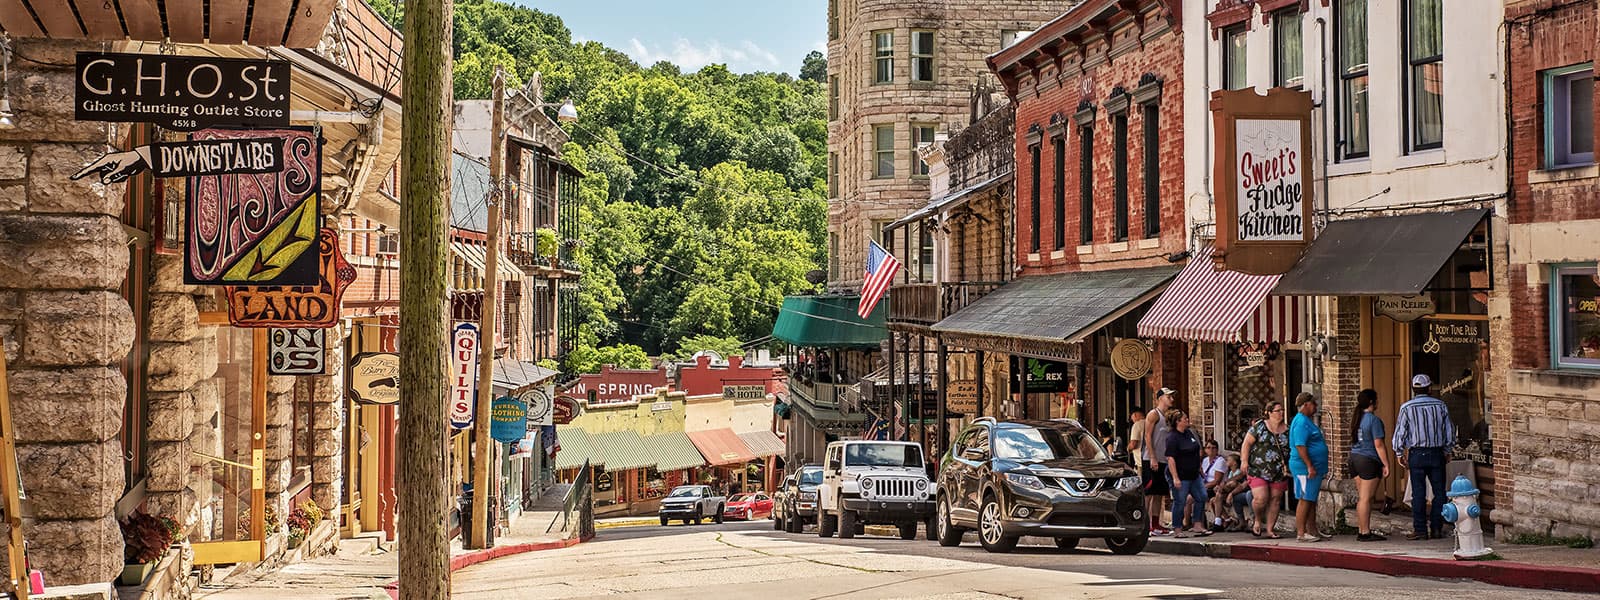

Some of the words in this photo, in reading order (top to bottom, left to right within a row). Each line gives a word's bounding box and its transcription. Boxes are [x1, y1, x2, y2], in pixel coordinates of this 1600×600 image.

[82, 58, 285, 102] G.H.O.St.
[83, 100, 125, 112] Ghost
[130, 102, 189, 117] Hunting
[193, 104, 240, 116] Outlet
[244, 106, 283, 118] Store
[160, 141, 275, 174] DOWNSTAIRS
[1241, 148, 1296, 189] Sweet's
[1246, 178, 1302, 213] Fudge
[1239, 211, 1302, 240] Kitchen
[237, 295, 329, 322] LAND
[1380, 300, 1399, 309] PAIN
[1401, 300, 1430, 309] RELIEF
[1579, 301, 1597, 311] OPEN
[1435, 324, 1450, 335] BODY
[1464, 324, 1478, 336] PLUS
[455, 337, 474, 413] QUILTS
[1016, 373, 1033, 382] TE
[1045, 372, 1063, 381] REX
[598, 383, 656, 395] SPRING
